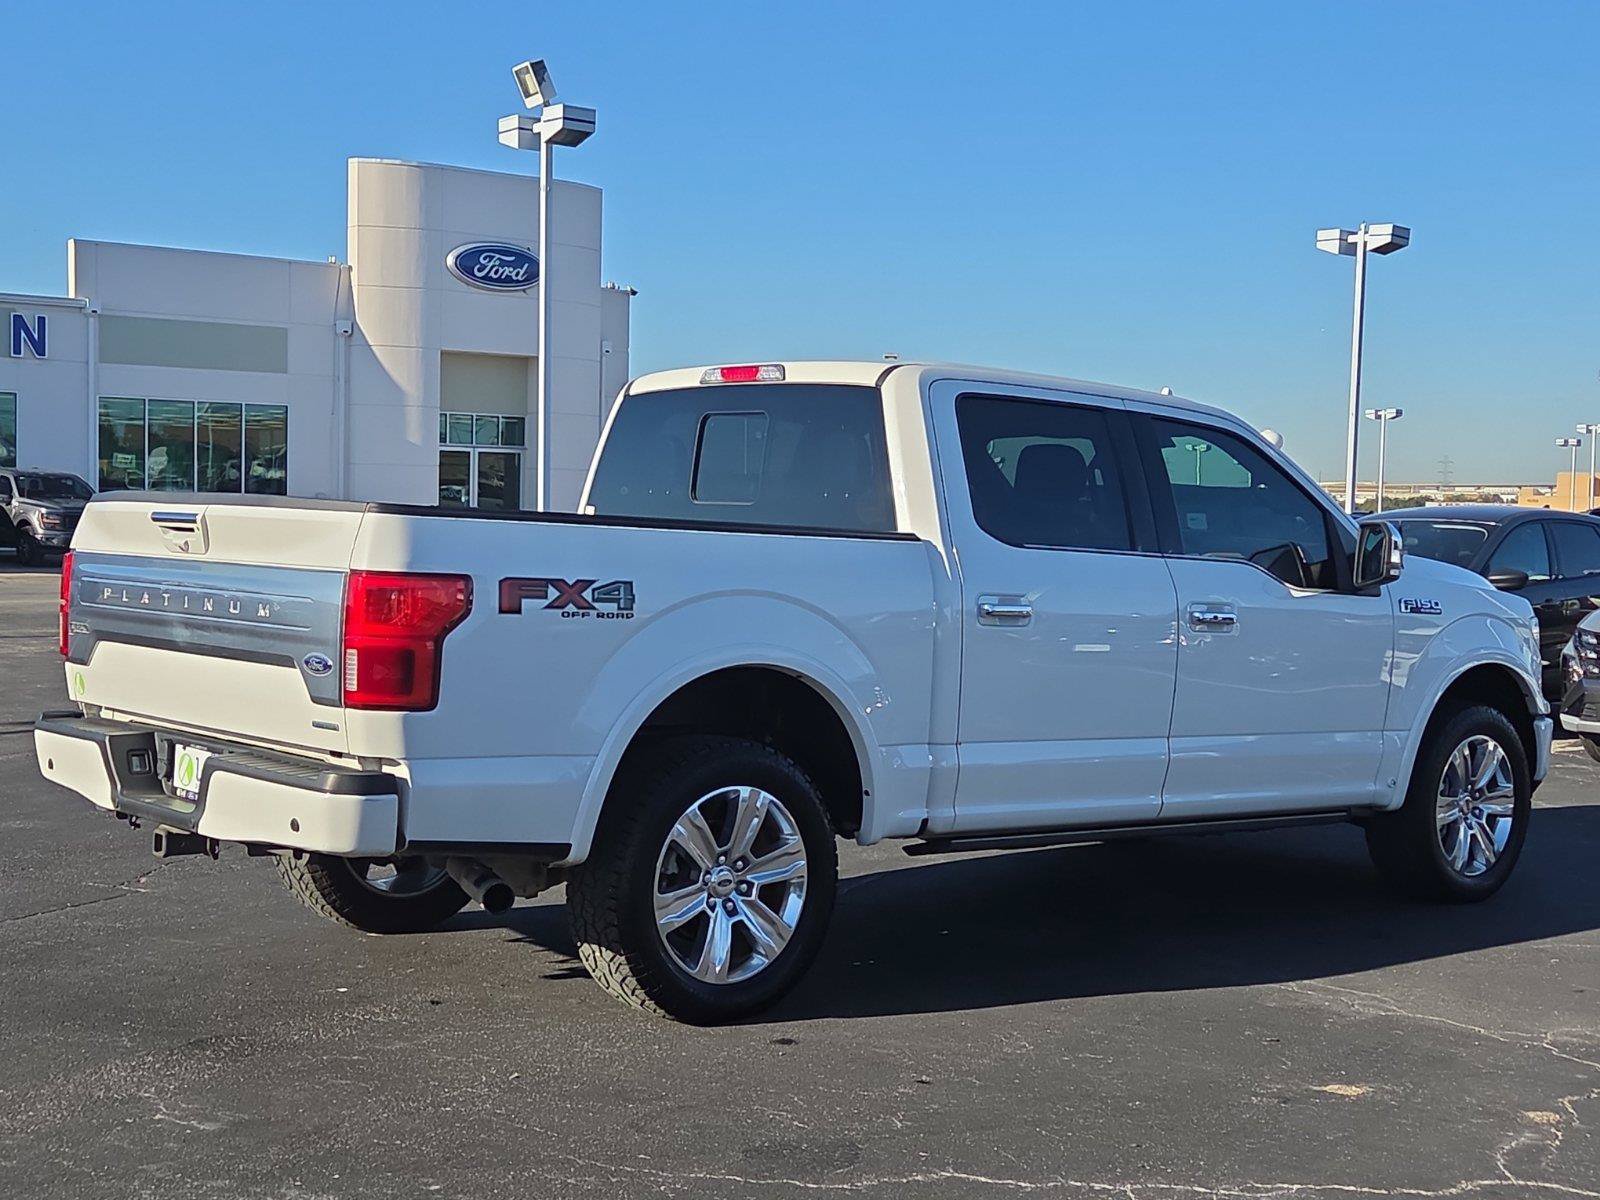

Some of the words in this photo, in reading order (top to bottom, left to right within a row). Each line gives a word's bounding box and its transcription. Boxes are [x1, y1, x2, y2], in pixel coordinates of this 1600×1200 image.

[474, 252, 529, 281] Ford
[10, 313, 47, 359] N
[102, 587, 271, 618] PLATINUM
[498, 576, 635, 614] FX4
[561, 611, 590, 619] OFF
[596, 611, 635, 619] ROAD
